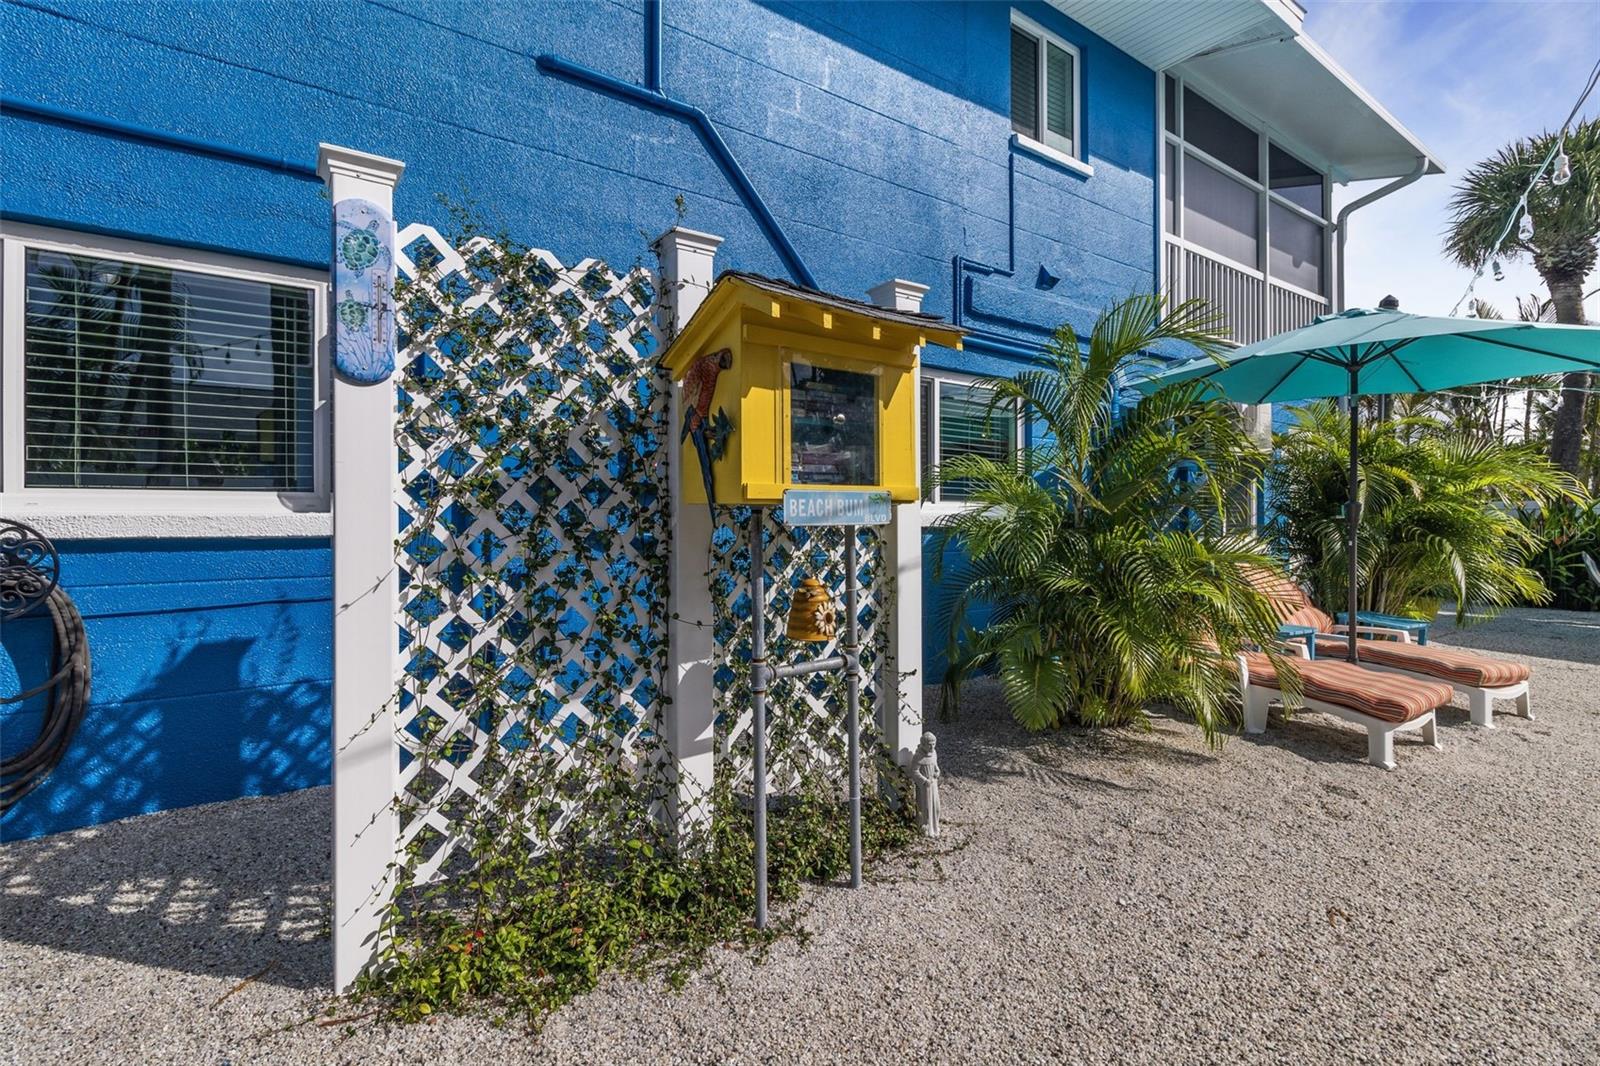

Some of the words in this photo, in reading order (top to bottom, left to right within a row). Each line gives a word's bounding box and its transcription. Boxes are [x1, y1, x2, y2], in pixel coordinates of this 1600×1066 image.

[789, 498, 833, 517] BEACH
[836, 498, 864, 517] BUM
[864, 513, 887, 522] BLVD
